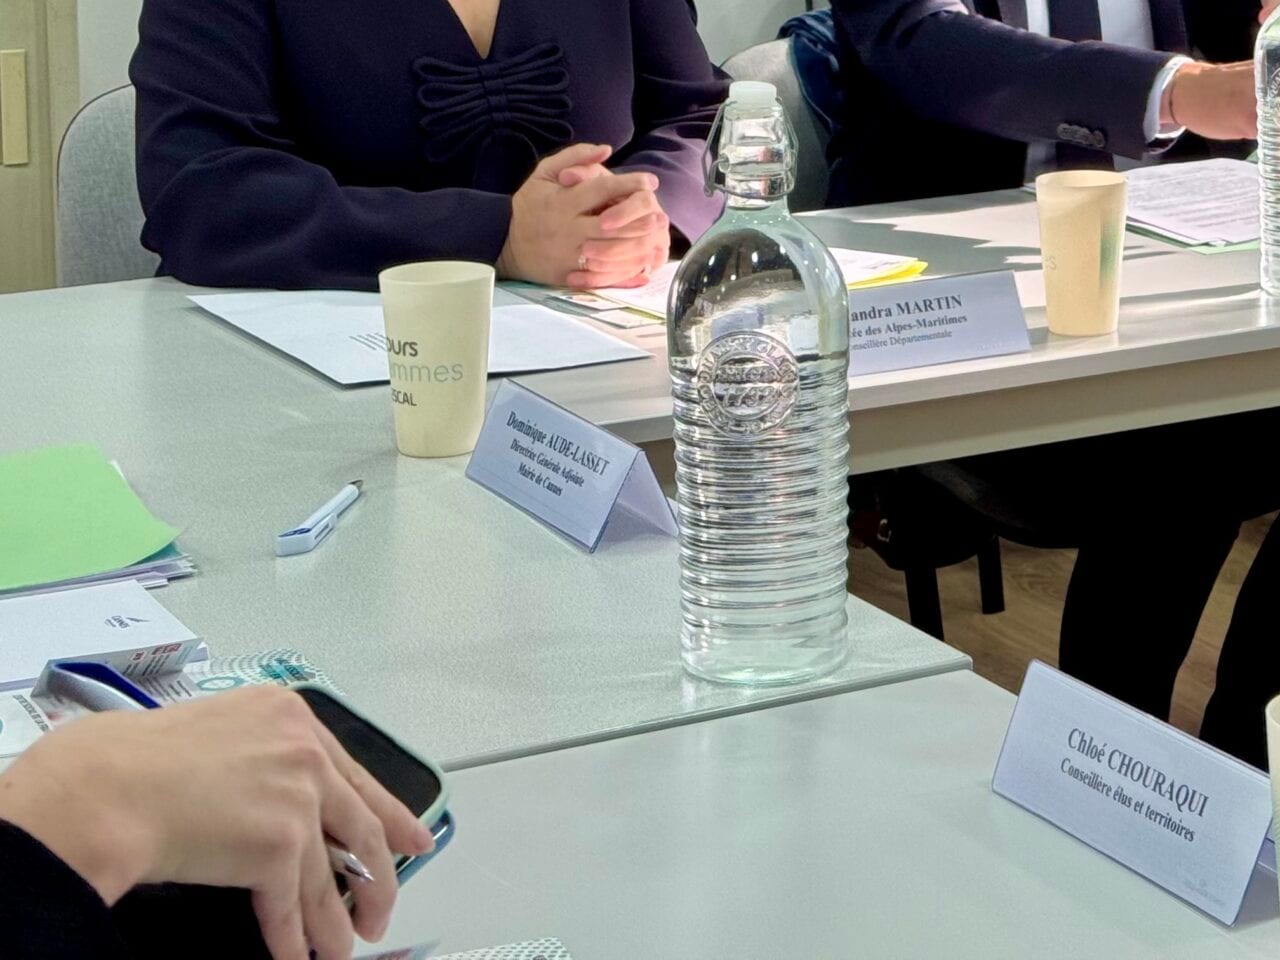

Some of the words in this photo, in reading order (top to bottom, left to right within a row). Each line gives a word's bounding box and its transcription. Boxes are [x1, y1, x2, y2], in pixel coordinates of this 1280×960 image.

[865, 326, 882, 336] des
[885, 314, 968, 334] Alpes-Maritimes
[896, 295, 963, 316] MARTIN
[890, 330, 952, 346] Départementale
[506, 411, 547, 445] Dominique
[548, 433, 610, 476] AUDE-LASSET
[510, 439, 537, 461] Directrice
[537, 452, 562, 474] Générale
[561, 464, 585, 487] Adjointe
[519, 462, 535, 481] Mairie
[535, 472, 542, 486] de
[542, 478, 563, 496] Cannes
[1067, 727, 1107, 764] Chloé
[1107, 748, 1209, 817] CHOURAQUI
[1060, 758, 1112, 795] Conseillère
[1112, 783, 1132, 808] élus
[1133, 801, 1144, 814] et
[1145, 804, 1196, 842] territoires
